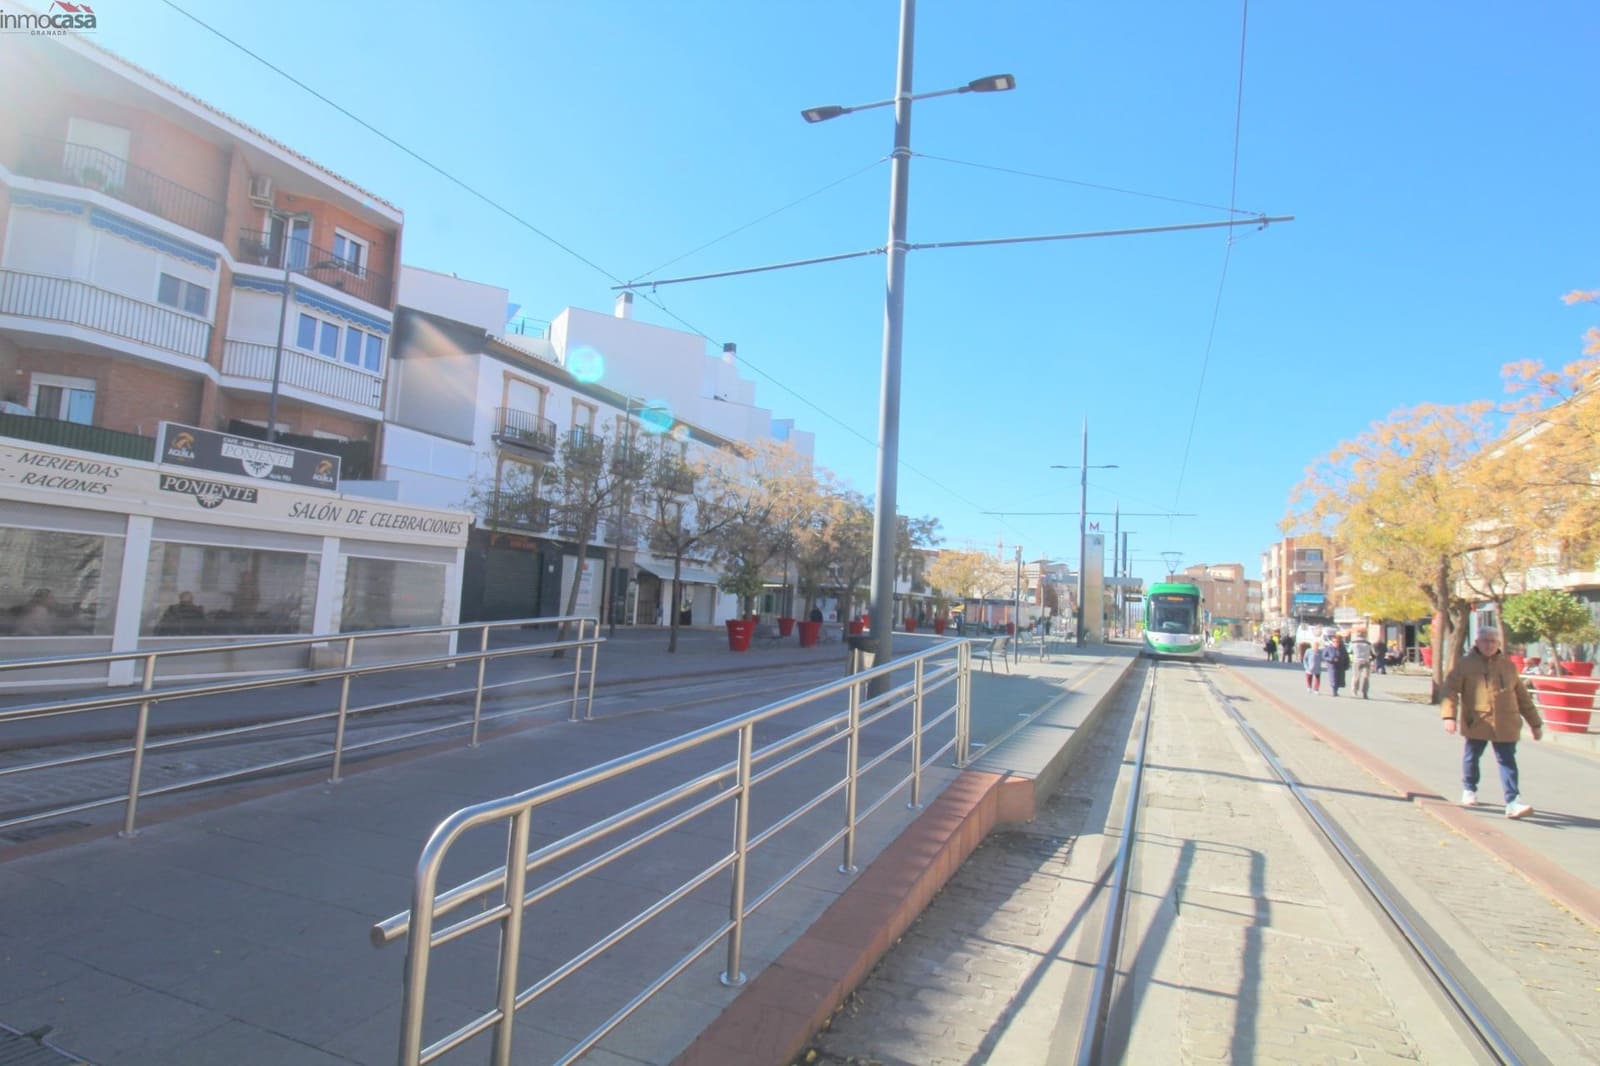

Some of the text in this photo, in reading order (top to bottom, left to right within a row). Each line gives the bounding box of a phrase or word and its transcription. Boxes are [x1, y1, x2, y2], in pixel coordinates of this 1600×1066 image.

[17, 452, 123, 479] MERIENDAS
[20, 472, 112, 494] RACIONES
[163, 476, 256, 501] PONIENTE
[288, 502, 464, 536] SALÓN DE CELEBRACIONES
[1089, 521, 1100, 531] M
